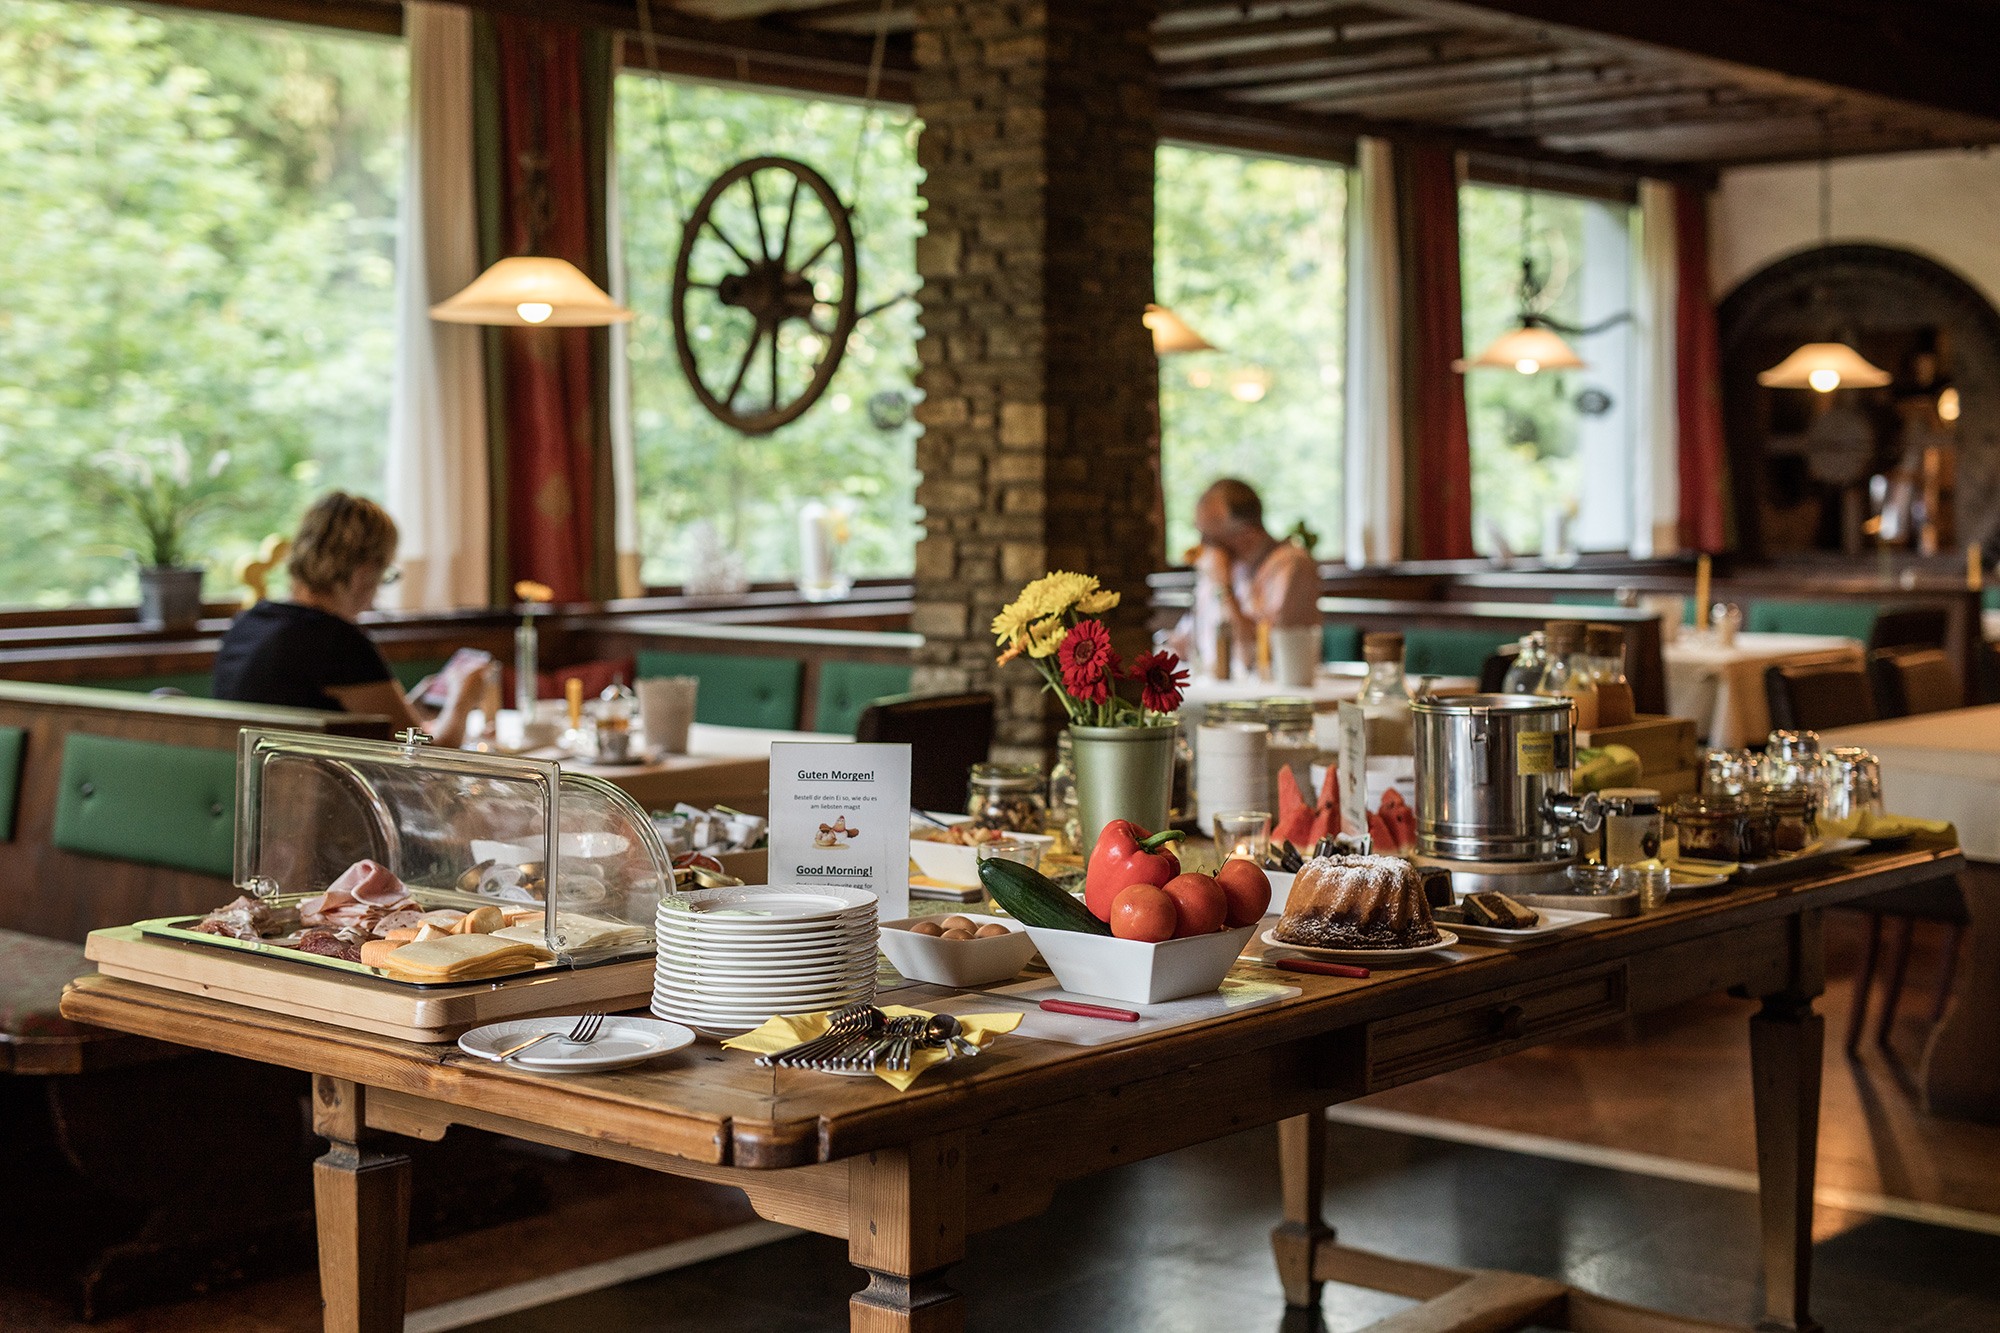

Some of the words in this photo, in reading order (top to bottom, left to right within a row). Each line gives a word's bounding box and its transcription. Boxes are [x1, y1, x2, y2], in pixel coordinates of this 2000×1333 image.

[797, 770, 829, 780] Guten
[831, 770, 875, 782] Morgen!
[796, 865, 824, 875] Good
[826, 865, 873, 877] Morning!
